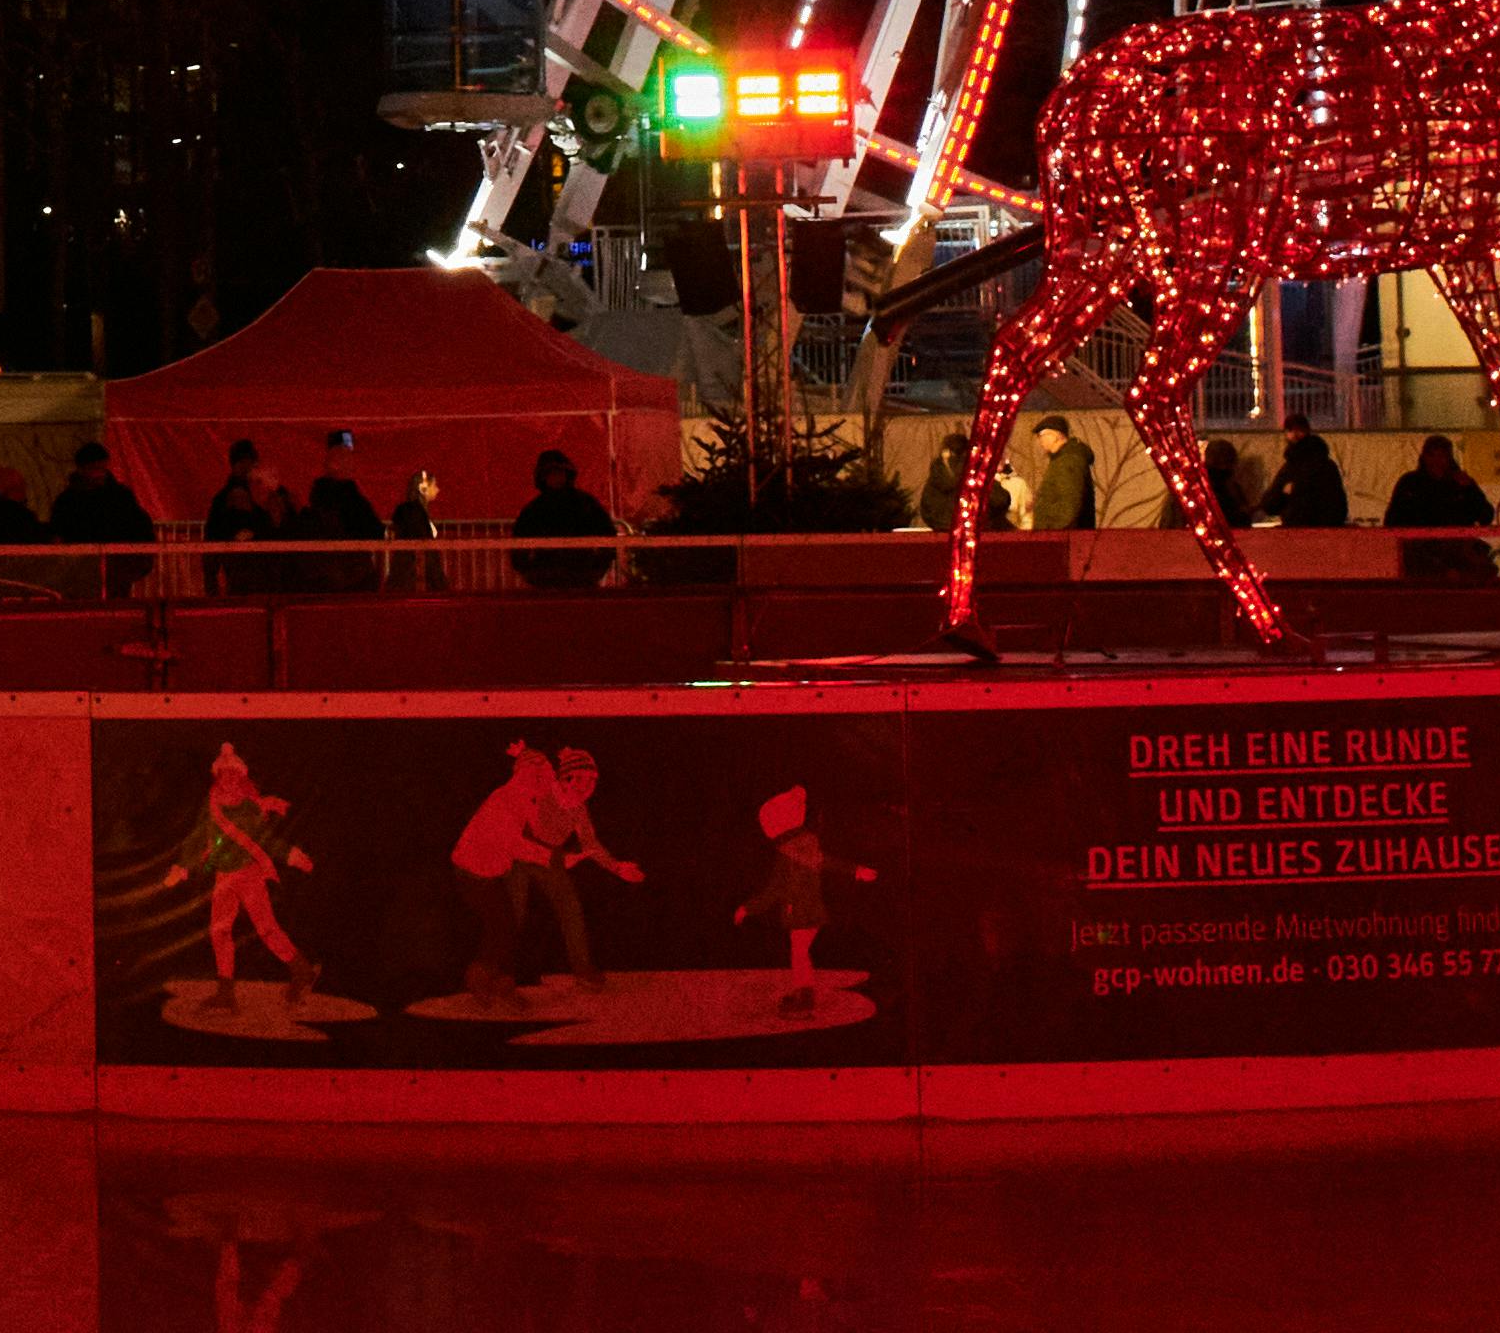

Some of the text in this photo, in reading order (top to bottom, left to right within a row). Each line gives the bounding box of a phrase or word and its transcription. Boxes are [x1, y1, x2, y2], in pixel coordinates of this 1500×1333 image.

[1129, 725, 1471, 770] DREH EINE RUNDE
[1159, 780, 1449, 824] UND ENTDECKE
[1086, 844, 1181, 881] DEIN
[1196, 840, 1322, 877] NEUES
[1069, 918, 1131, 952] Jetzt
[1139, 914, 1268, 949] passende
[1274, 910, 1449, 942] Mietwohnung
[1092, 955, 1305, 995] gcp-wohnen.de
[1327, 953, 1379, 982] 030
[1385, 951, 1434, 980] 346
[1441, 948, 1473, 977] 55
